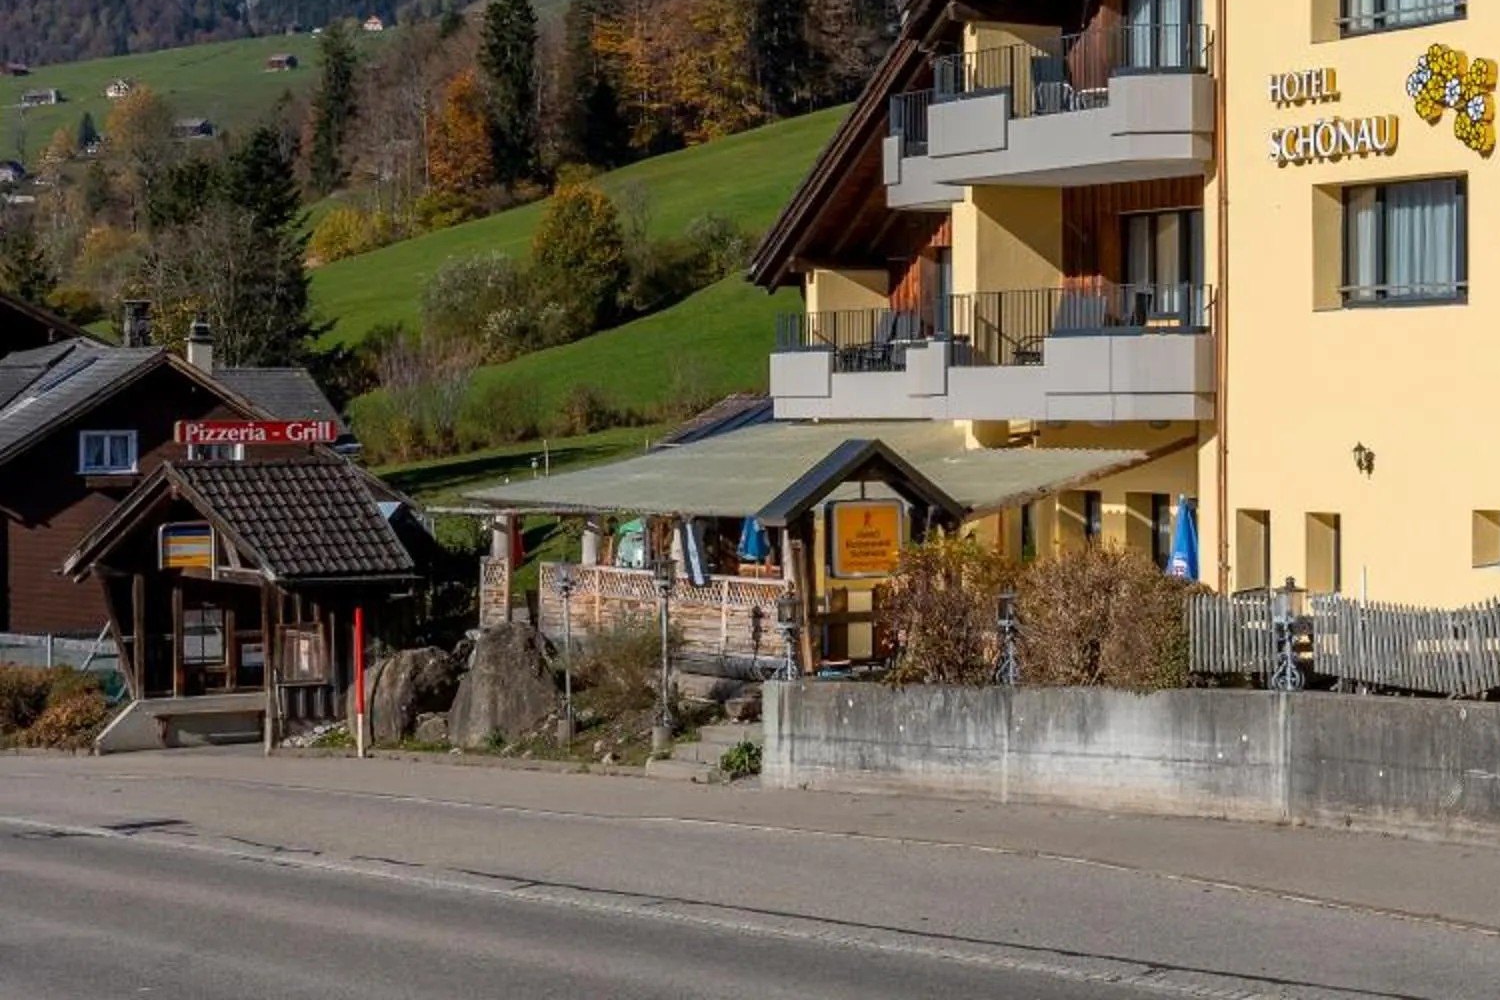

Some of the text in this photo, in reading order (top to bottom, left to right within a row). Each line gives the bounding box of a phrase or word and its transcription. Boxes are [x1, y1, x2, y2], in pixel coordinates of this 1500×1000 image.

[1269, 67, 1337, 101] HOTEL
[1268, 116, 1391, 161] SCHÖNAU
[185, 422, 266, 441] Pizzeria
[285, 421, 330, 441] Grill
